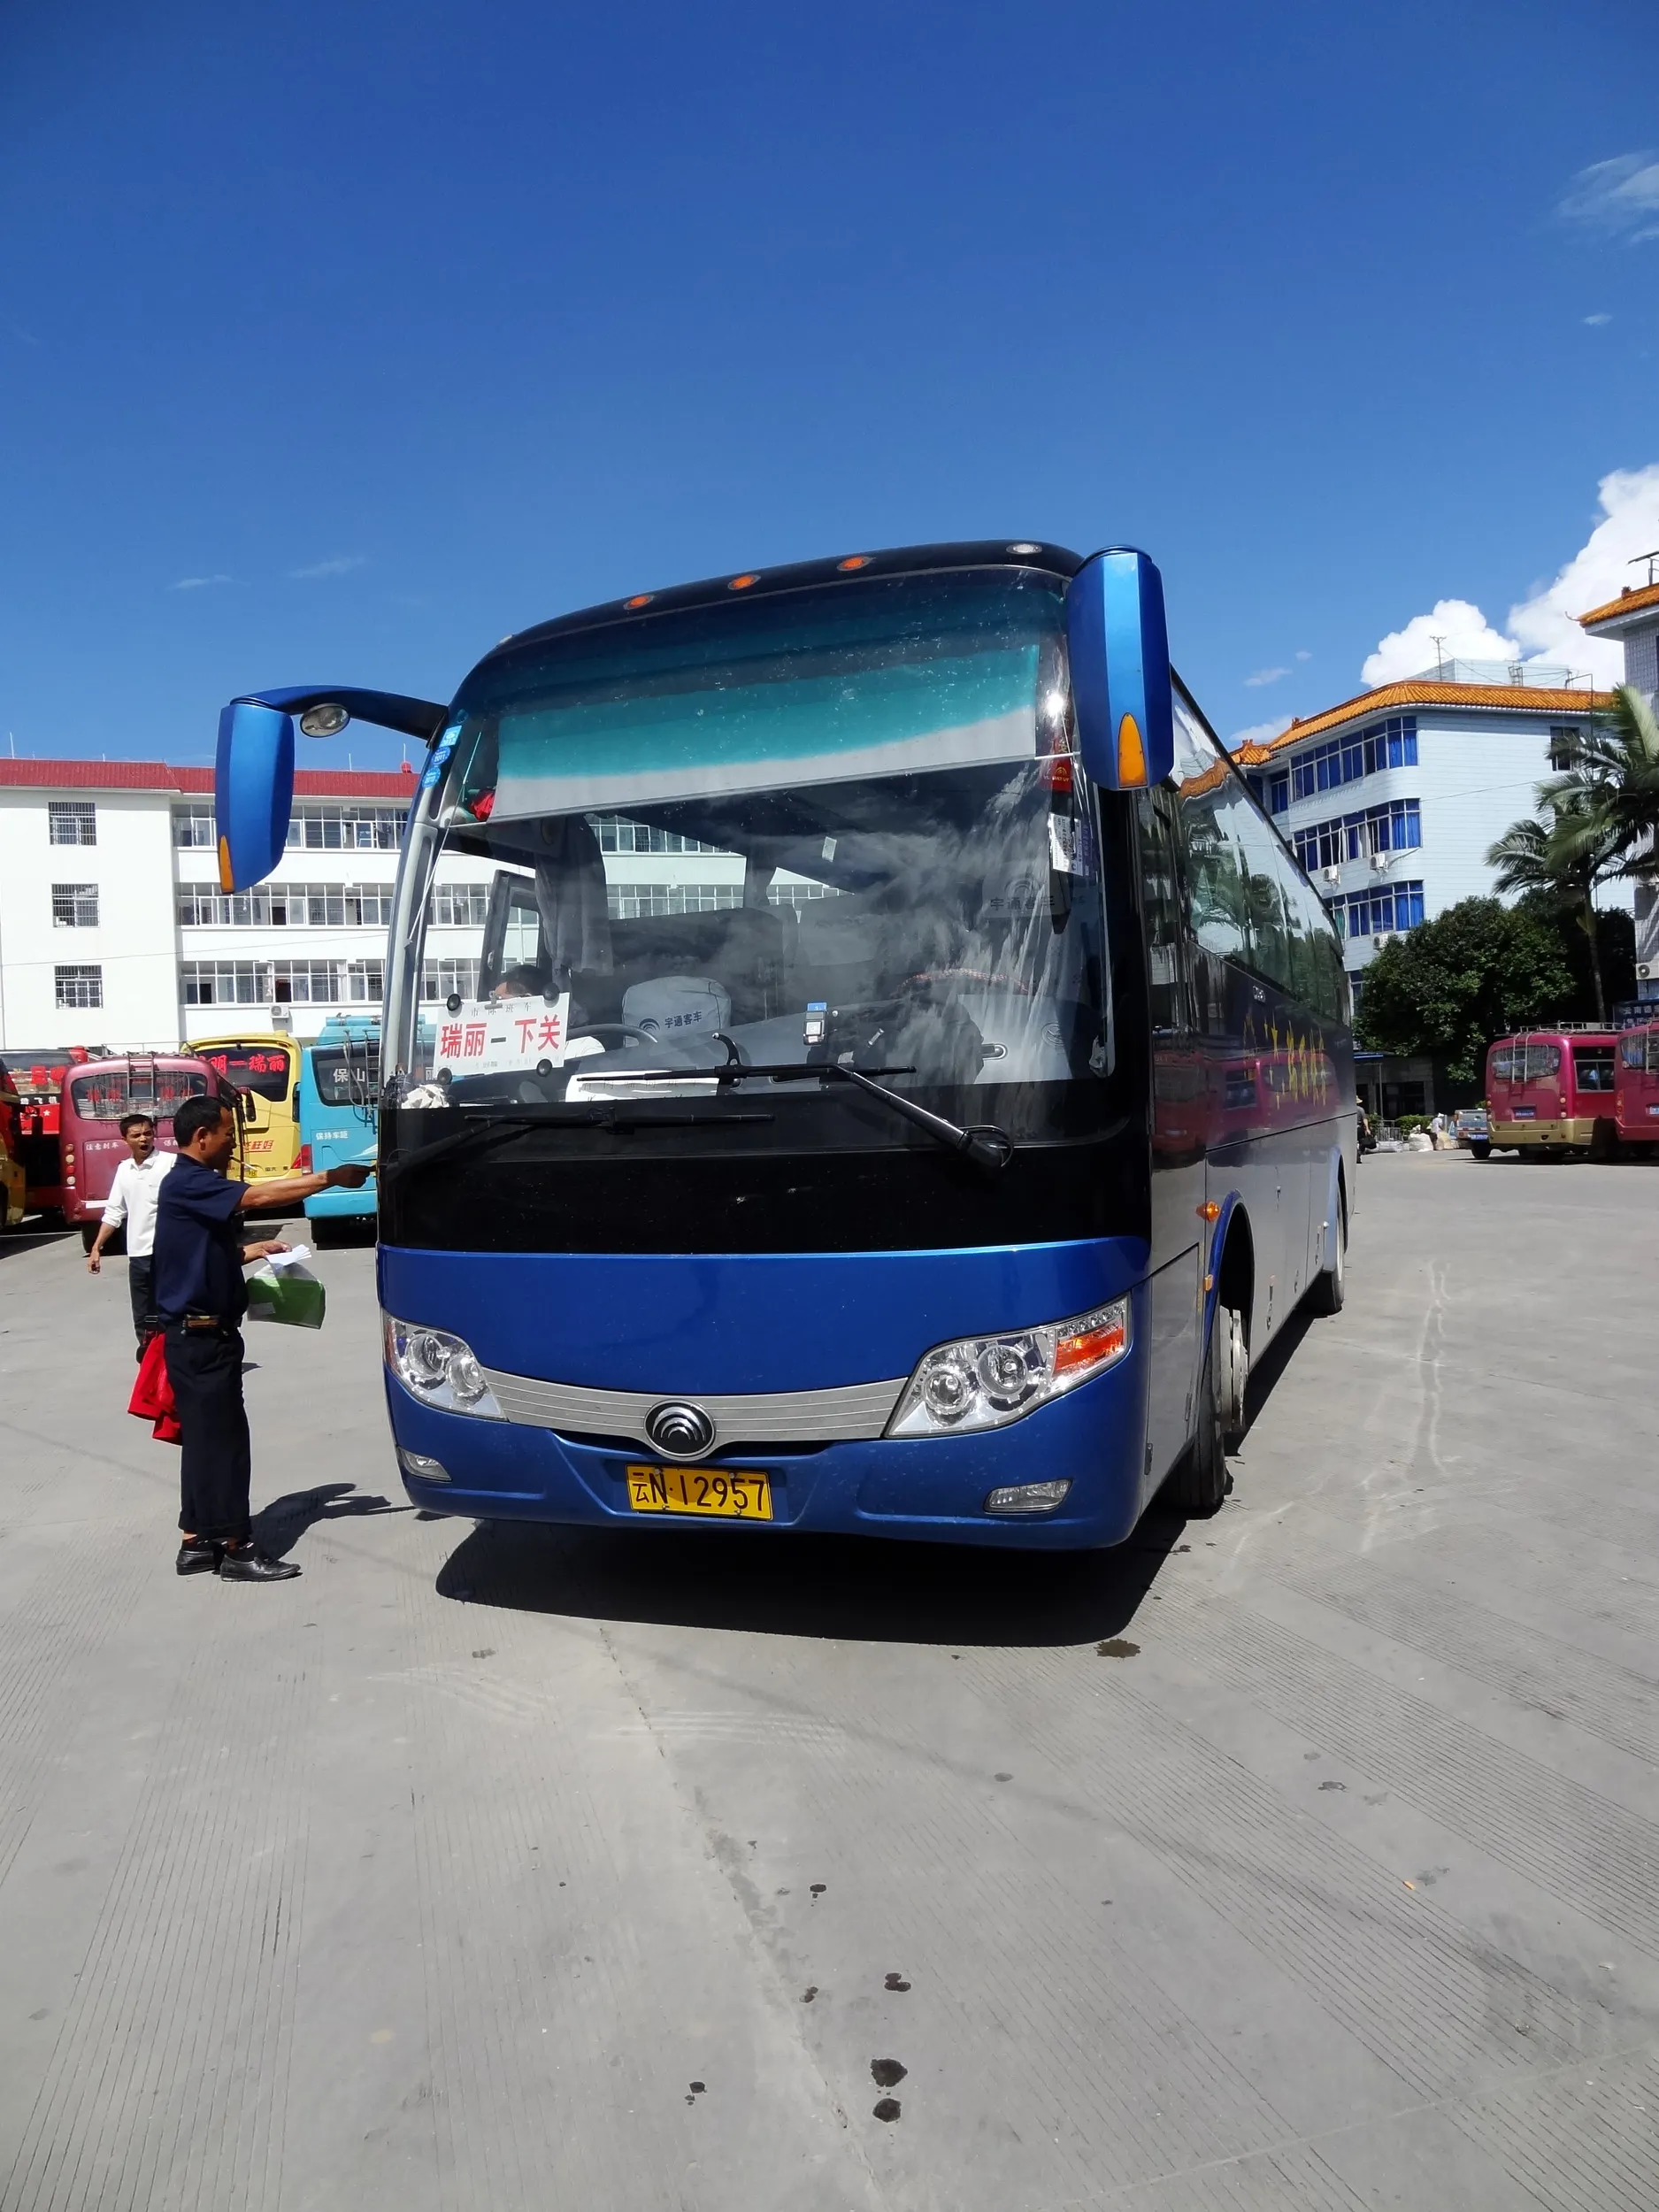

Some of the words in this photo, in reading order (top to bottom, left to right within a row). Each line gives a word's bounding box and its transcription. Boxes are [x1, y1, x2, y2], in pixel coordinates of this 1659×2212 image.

[664, 1011, 702, 1028] 宇通客车
[333, 1068, 365, 1083] 保山
